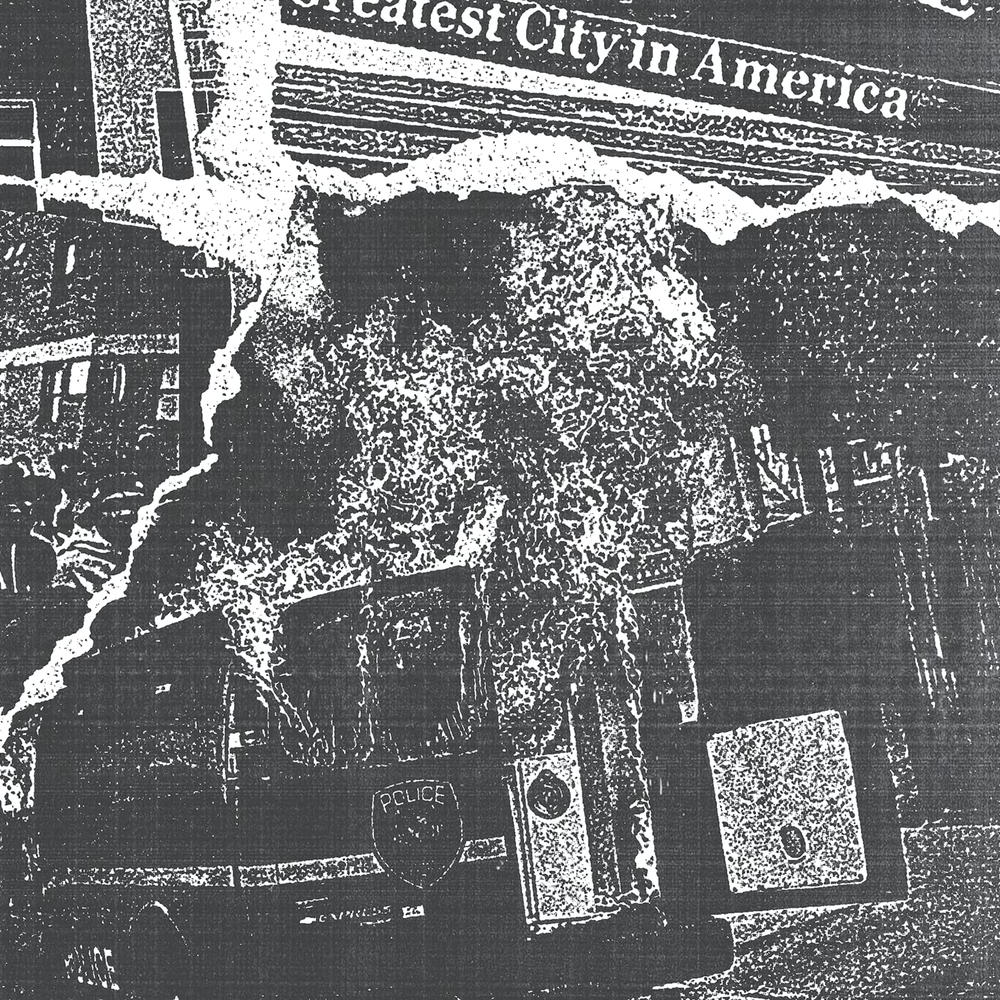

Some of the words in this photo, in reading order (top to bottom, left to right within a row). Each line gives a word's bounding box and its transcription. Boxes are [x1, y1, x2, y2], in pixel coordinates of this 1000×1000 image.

[516, 4, 617, 74] City
[633, 25, 679, 77] in
[693, 38, 908, 122] America
[380, 785, 446, 813] POLICE
